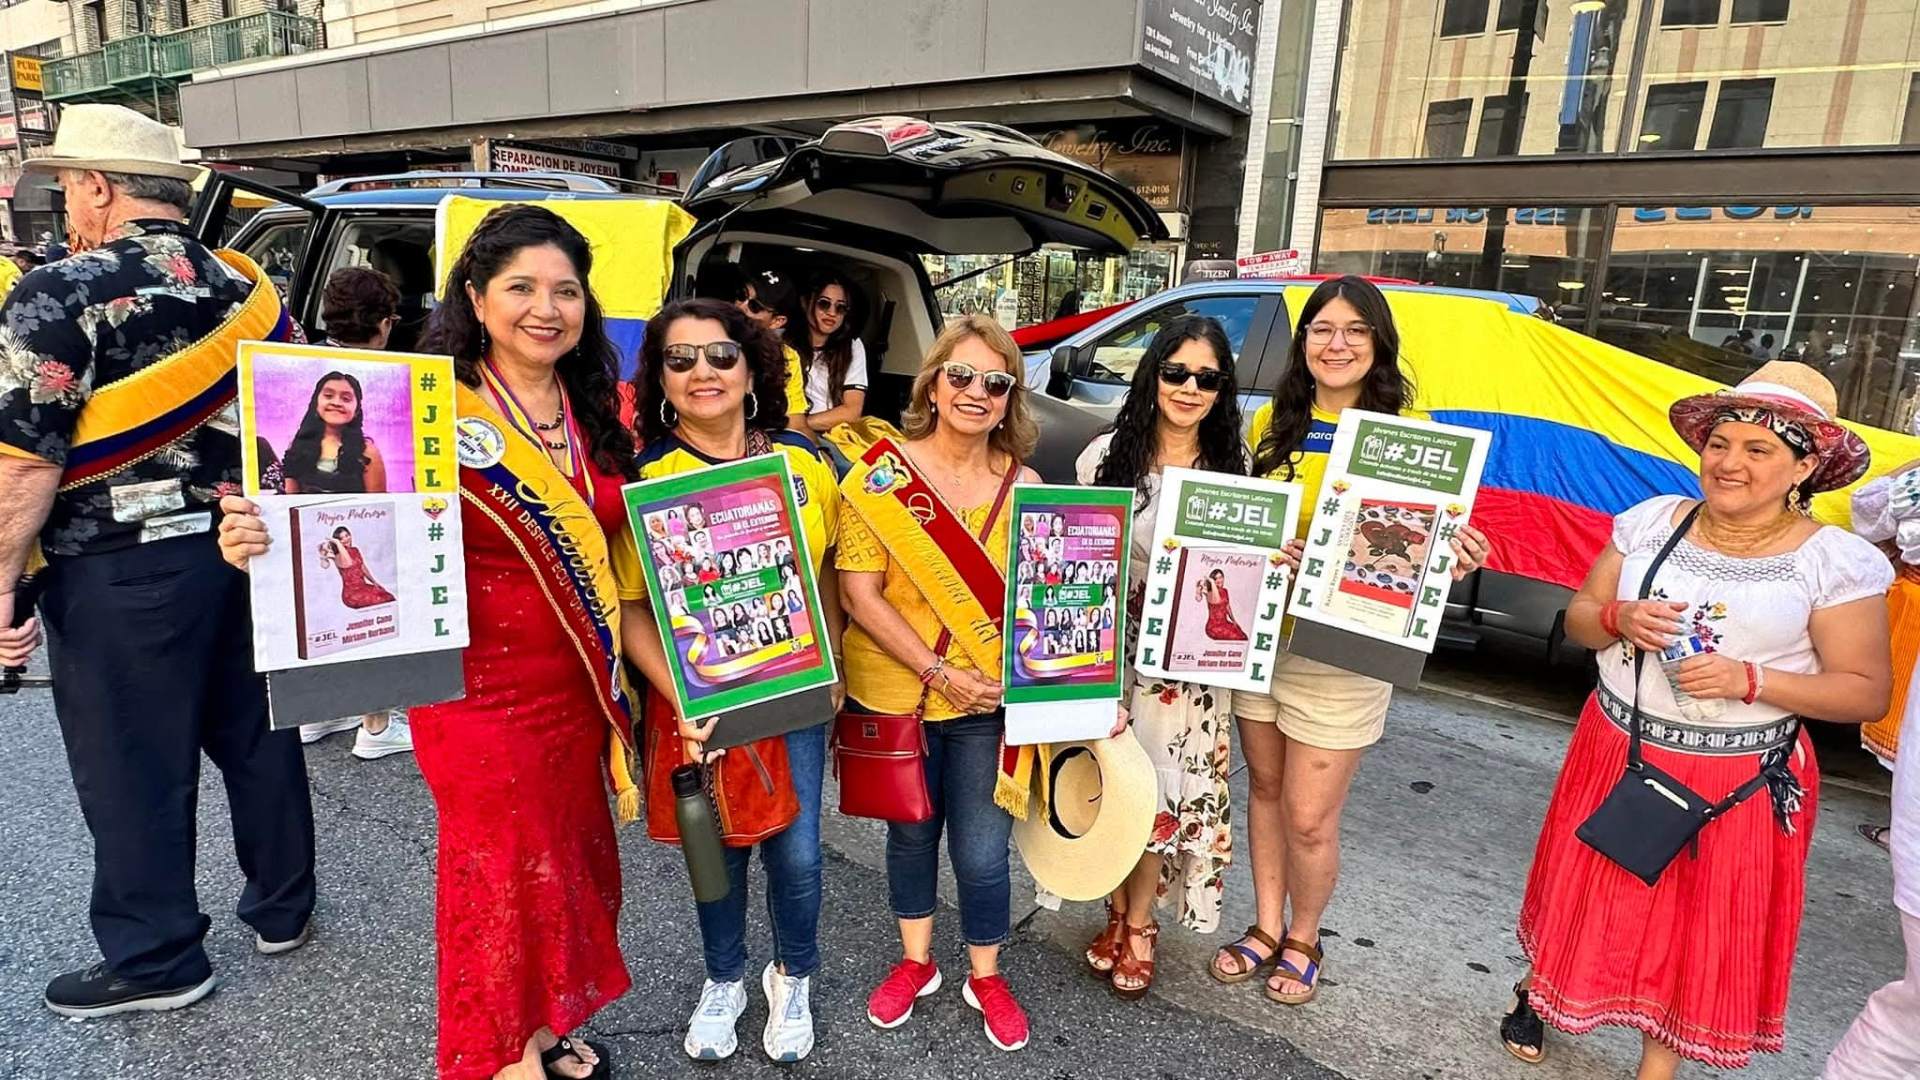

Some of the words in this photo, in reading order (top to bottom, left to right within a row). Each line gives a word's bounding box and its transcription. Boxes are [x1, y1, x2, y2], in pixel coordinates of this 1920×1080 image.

[16, 60, 39, 70] PUBL
[493, 147, 560, 170] REPARACION
[562, 159, 575, 171] DE
[578, 161, 618, 177] JOYERIA
[1244, 250, 1292, 265] TOW-AWAY
[1383, 442, 1459, 474] #JEL
[316, 510, 345, 527] Mujer
[347, 508, 387, 521] Poderosa
[710, 499, 777, 525] ECUATORIANAS
[1208, 501, 1278, 529] #JEL
[487, 483, 519, 511] XXII
[517, 510, 556, 562] DESFILE
[1067, 525, 1116, 536] ECUATORIANAS
[1200, 553, 1224, 569] Mujer
[1224, 555, 1259, 569] Poderosa
[346, 617, 375, 632] Jennifer
[376, 614, 393, 625] Cano
[342, 632, 367, 645] Miriam
